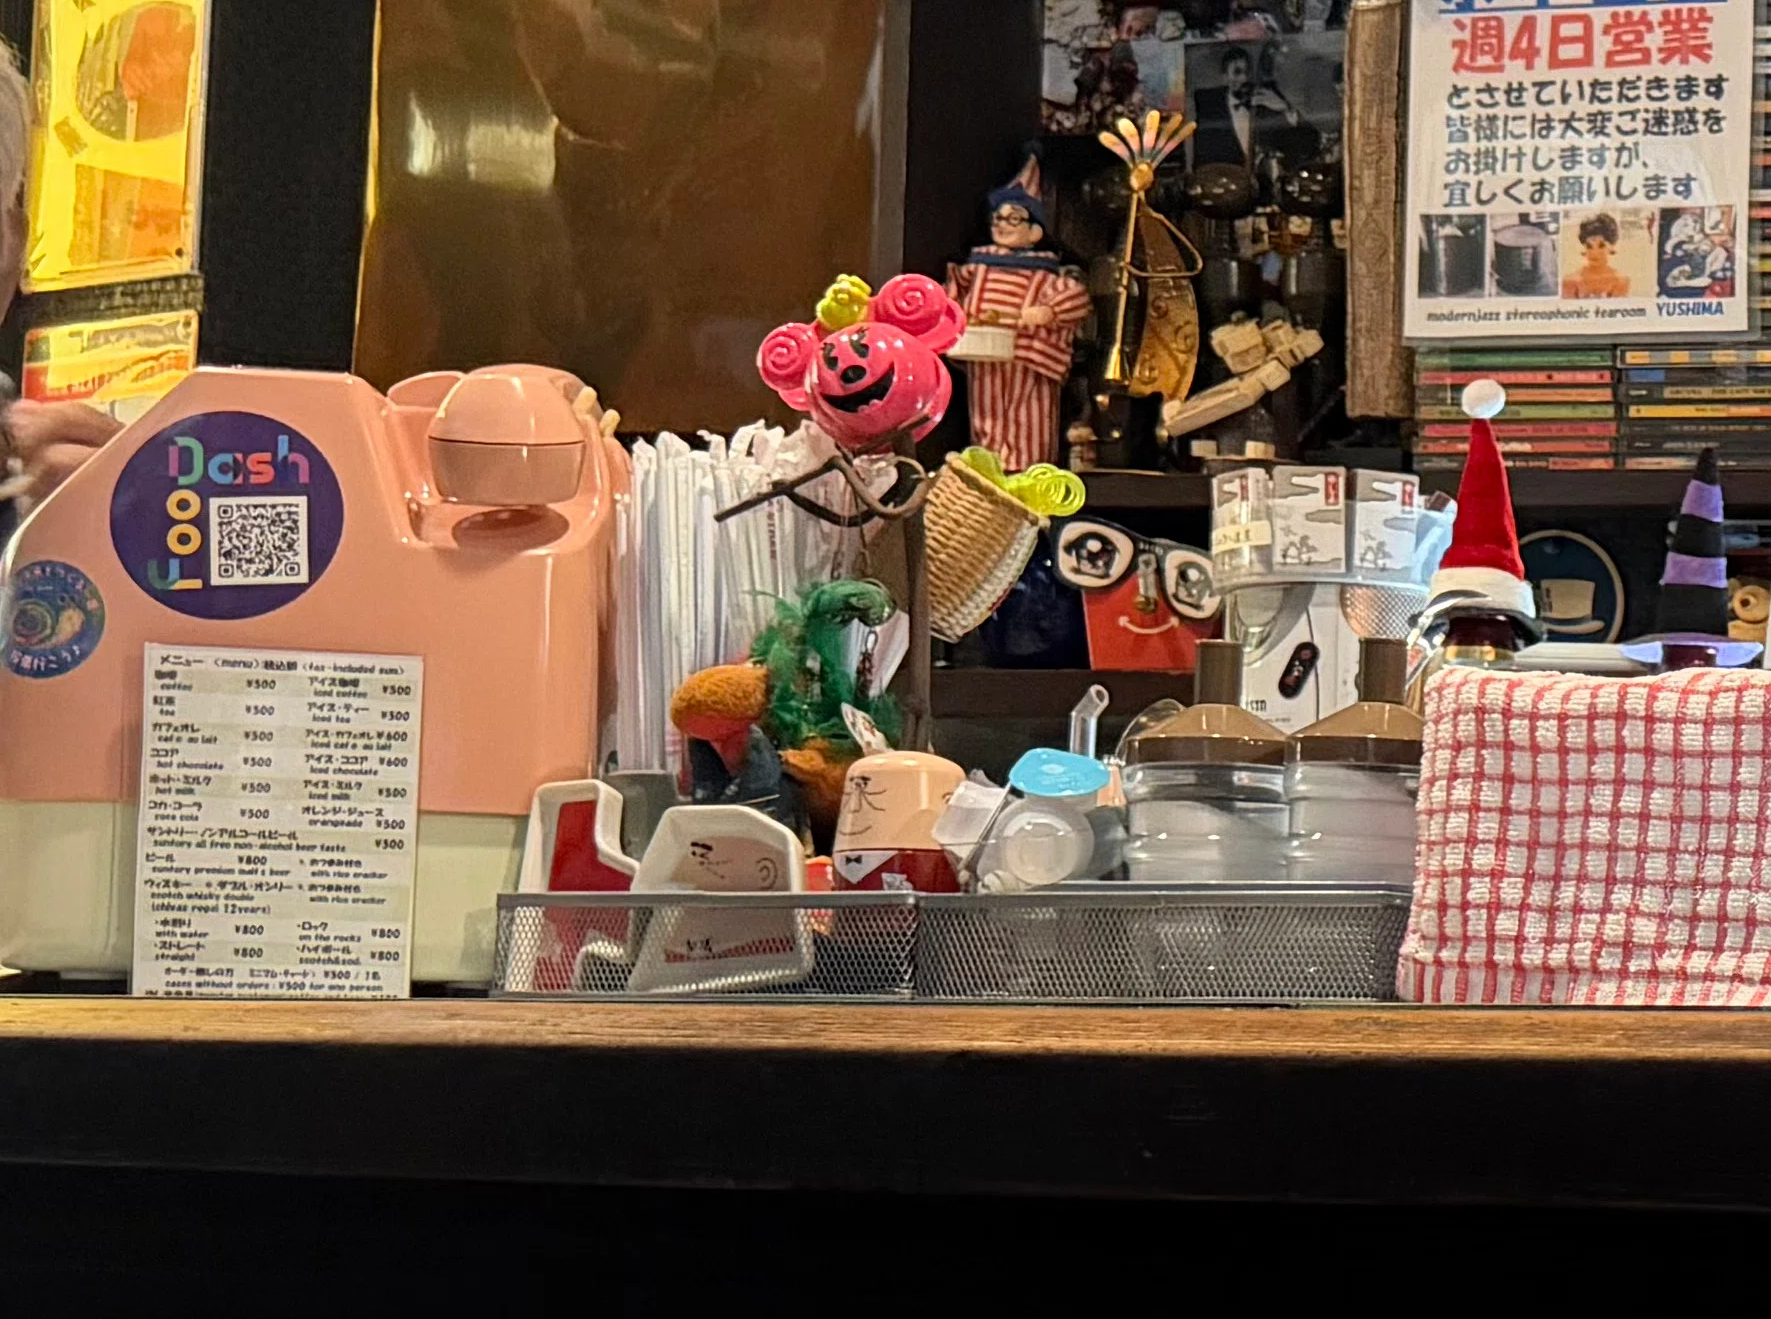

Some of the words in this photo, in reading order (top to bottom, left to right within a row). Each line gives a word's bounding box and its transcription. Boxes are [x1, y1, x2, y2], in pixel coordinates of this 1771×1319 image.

[1451, 7, 1714, 74] 週4日営業
[1447, 74, 1730, 110] とさせていただきます
[1446, 108, 1727, 143] 皆様には大変ご迷惑を
[1443, 173, 1698, 208] 宜しくお願いします
[1656, 301, 1725, 318] YUSHIMA
[168, 434, 310, 486] Dash
[382, 685, 411, 696] ¥500
[380, 711, 410, 722] ¥500
